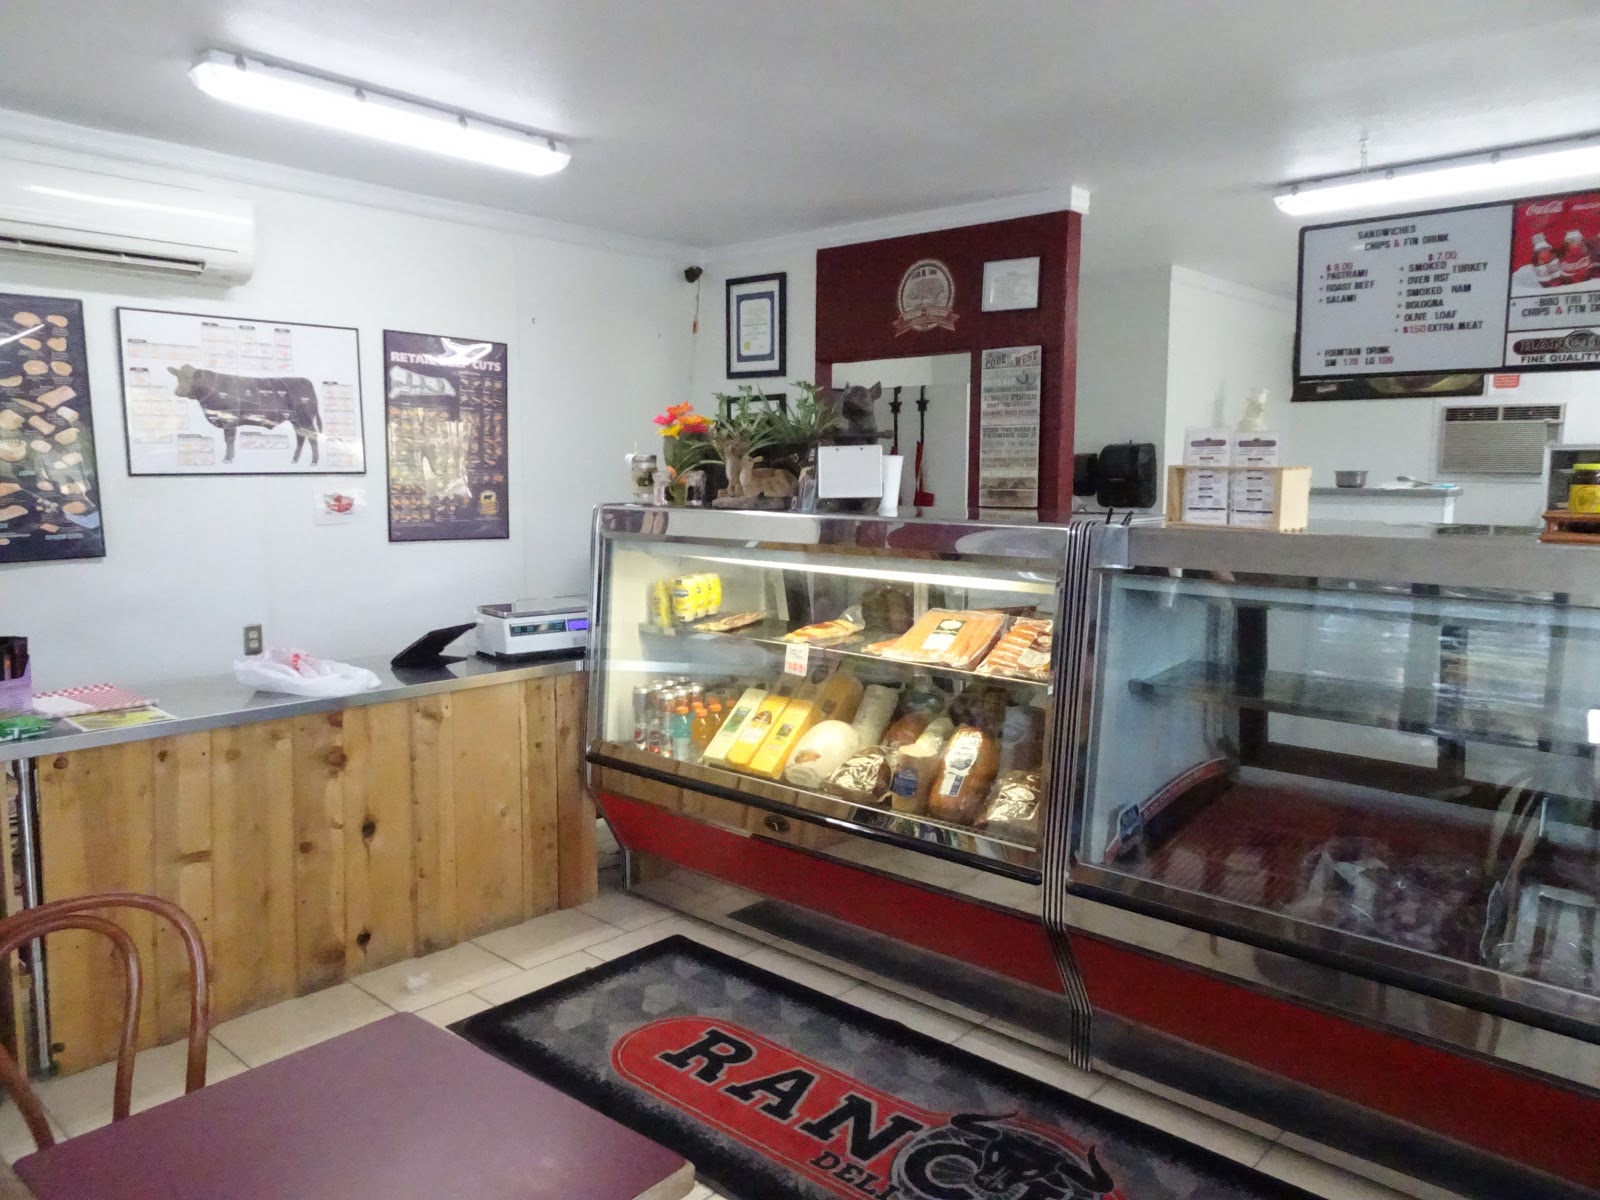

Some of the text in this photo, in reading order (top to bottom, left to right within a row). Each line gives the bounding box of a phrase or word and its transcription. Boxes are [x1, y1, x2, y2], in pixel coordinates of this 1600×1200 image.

[1358, 225, 1416, 239] SANDWICHES
[1364, 240, 1391, 251] CHIPS
[1393, 239, 1400, 248] &
[1422, 233, 1449, 245] DRINK
[1408, 261, 1488, 273] SMOKED TURKEY
[1326, 268, 1368, 280] PASTRAMI
[1407, 274, 1430, 285] OVEN
[1326, 280, 1375, 292] ROAST BEEF
[1406, 284, 1472, 297] SMOKED HAM
[1325, 294, 1357, 304] SALAMI
[1405, 299, 1444, 310] BOLOGNA
[1404, 309, 1457, 322] OLIVE LOAF
[1521, 307, 1550, 318] CHIPS
[1555, 306, 1563, 315] &
[1427, 322, 1455, 333] EXTRA
[1456, 320, 1483, 331] MEAT
[1014, 350, 1038, 366] WEST
[1324, 345, 1390, 358] FOUNTAIN DRINK
[1521, 351, 1600, 364] FINE QUALITY
[985, 353, 1007, 369] CODE
[657, 1028, 1075, 1200] RANC
